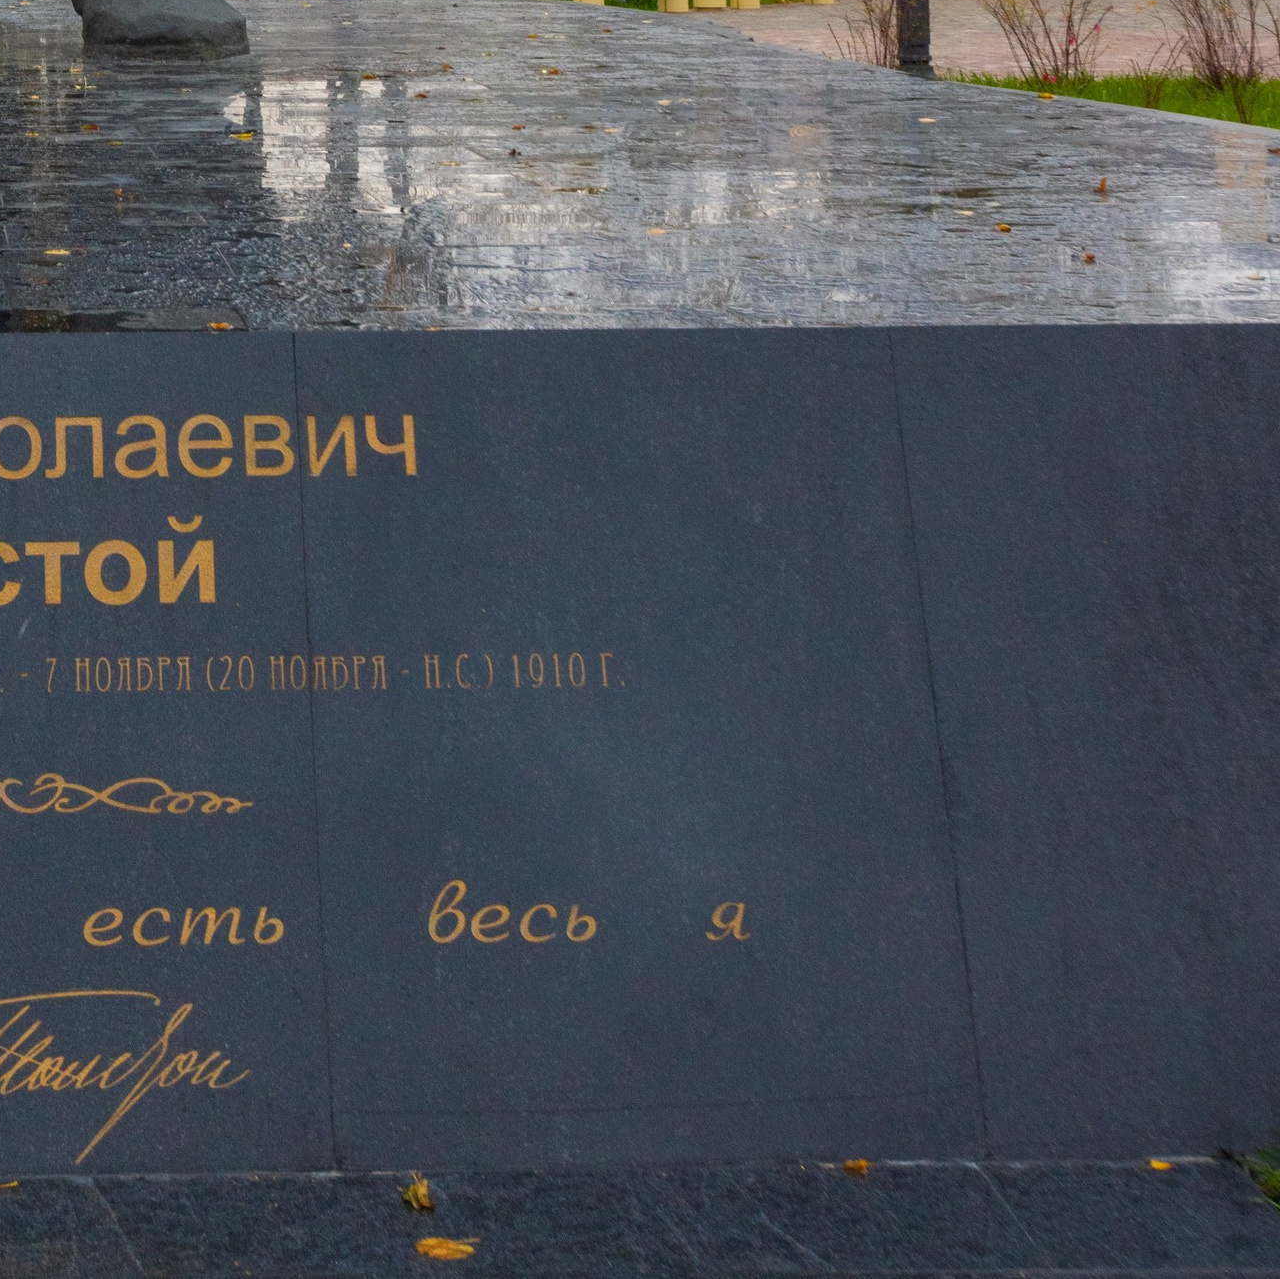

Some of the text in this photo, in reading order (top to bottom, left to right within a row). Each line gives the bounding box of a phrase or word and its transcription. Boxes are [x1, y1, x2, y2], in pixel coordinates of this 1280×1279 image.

[45, 657, 58, 693] 7
[75, 656, 191, 692] НОЯБРЯ
[206, 655, 255, 691] (20
[269, 654, 387, 690] НОЯБРЯ
[424, 653, 494, 690] Н.С.)
[512, 652, 586, 688] 1910
[82, 906, 285, 947] есть
[428, 879, 598, 944] весь
[706, 902, 748, 941] я
